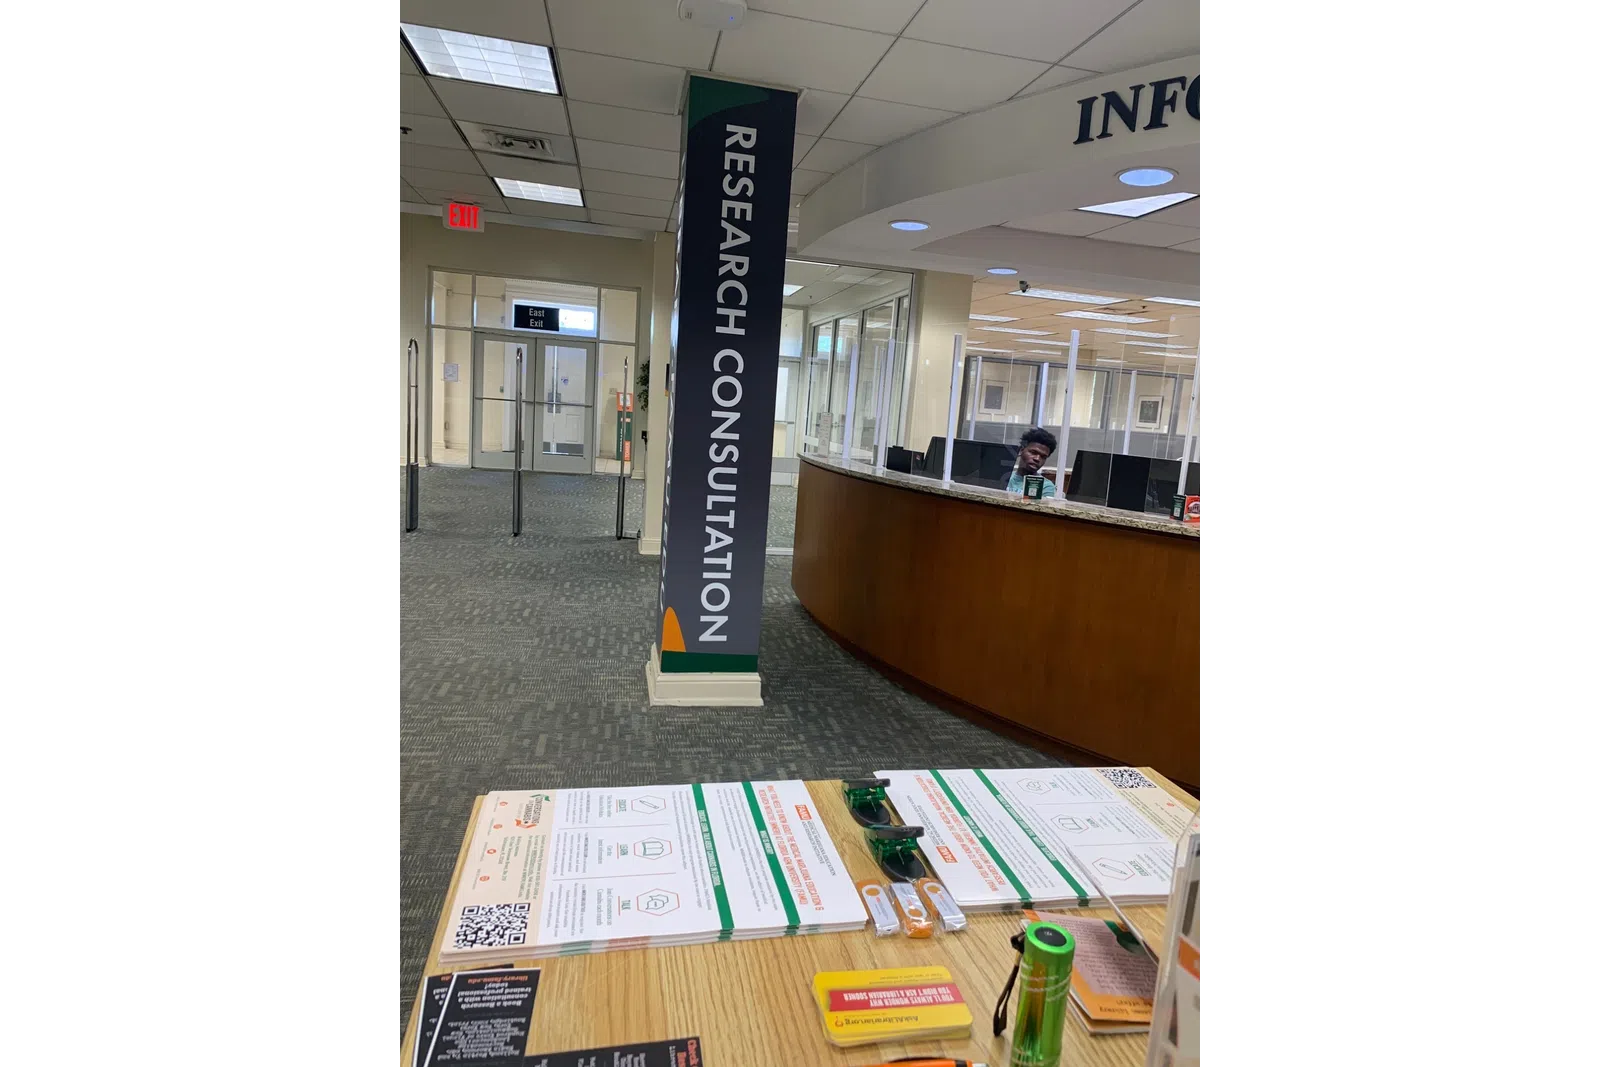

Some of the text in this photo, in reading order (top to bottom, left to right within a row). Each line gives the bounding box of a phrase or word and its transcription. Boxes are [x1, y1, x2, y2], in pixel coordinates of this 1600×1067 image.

[448, 203, 480, 230] EXIT
[528, 307, 545, 318] East
[529, 319, 544, 328] Exit
[698, 123, 758, 643] RESEARCH CONSULTATION
[757, 789, 770, 805] RESEARCH
[771, 799, 782, 808] NEED
[931, 788, 949, 805] UNIVERSITY
[521, 803, 533, 820] CANNABIS
[530, 797, 543, 823] CONVERSATIONS
[795, 805, 811, 819] FAMU
[777, 813, 788, 823] KNOW
[781, 824, 792, 835] ABOUT
[785, 835, 796, 843] THE
[619, 843, 628, 856] LEARN
[775, 840, 789, 855] FLORIDA
[788, 842, 802, 858] MEDICAL
[936, 846, 956, 862] FAMU
[959, 843, 972, 853] KNOW
[795, 858, 811, 880] MARIJUANA
[970, 859, 984, 869] NEED
[1127, 859, 1149, 876] EDUCATE
[785, 865, 802, 888] UNIVERSITY
[977, 869, 990, 878] YOU
[985, 864, 1006, 885] RESEARCH
[984, 879, 999, 891] WHAT
[793, 888, 809, 905] (FAMU)
[804, 880, 822, 905] EDUCATION
[620, 899, 631, 910] TALK
[457, 987, 504, 997] professional
[484, 981, 509, 990] today!
[504, 987, 532, 995] trained
[482, 993, 528, 1001] consultation
[843, 986, 950, 1001] YOU DIDN'T ASK A LIBRARIAN SOONER
[460, 1001, 496, 1010] Research
[869, 994, 954, 1008] YOU'LL ALWAYS WONDER WHY
